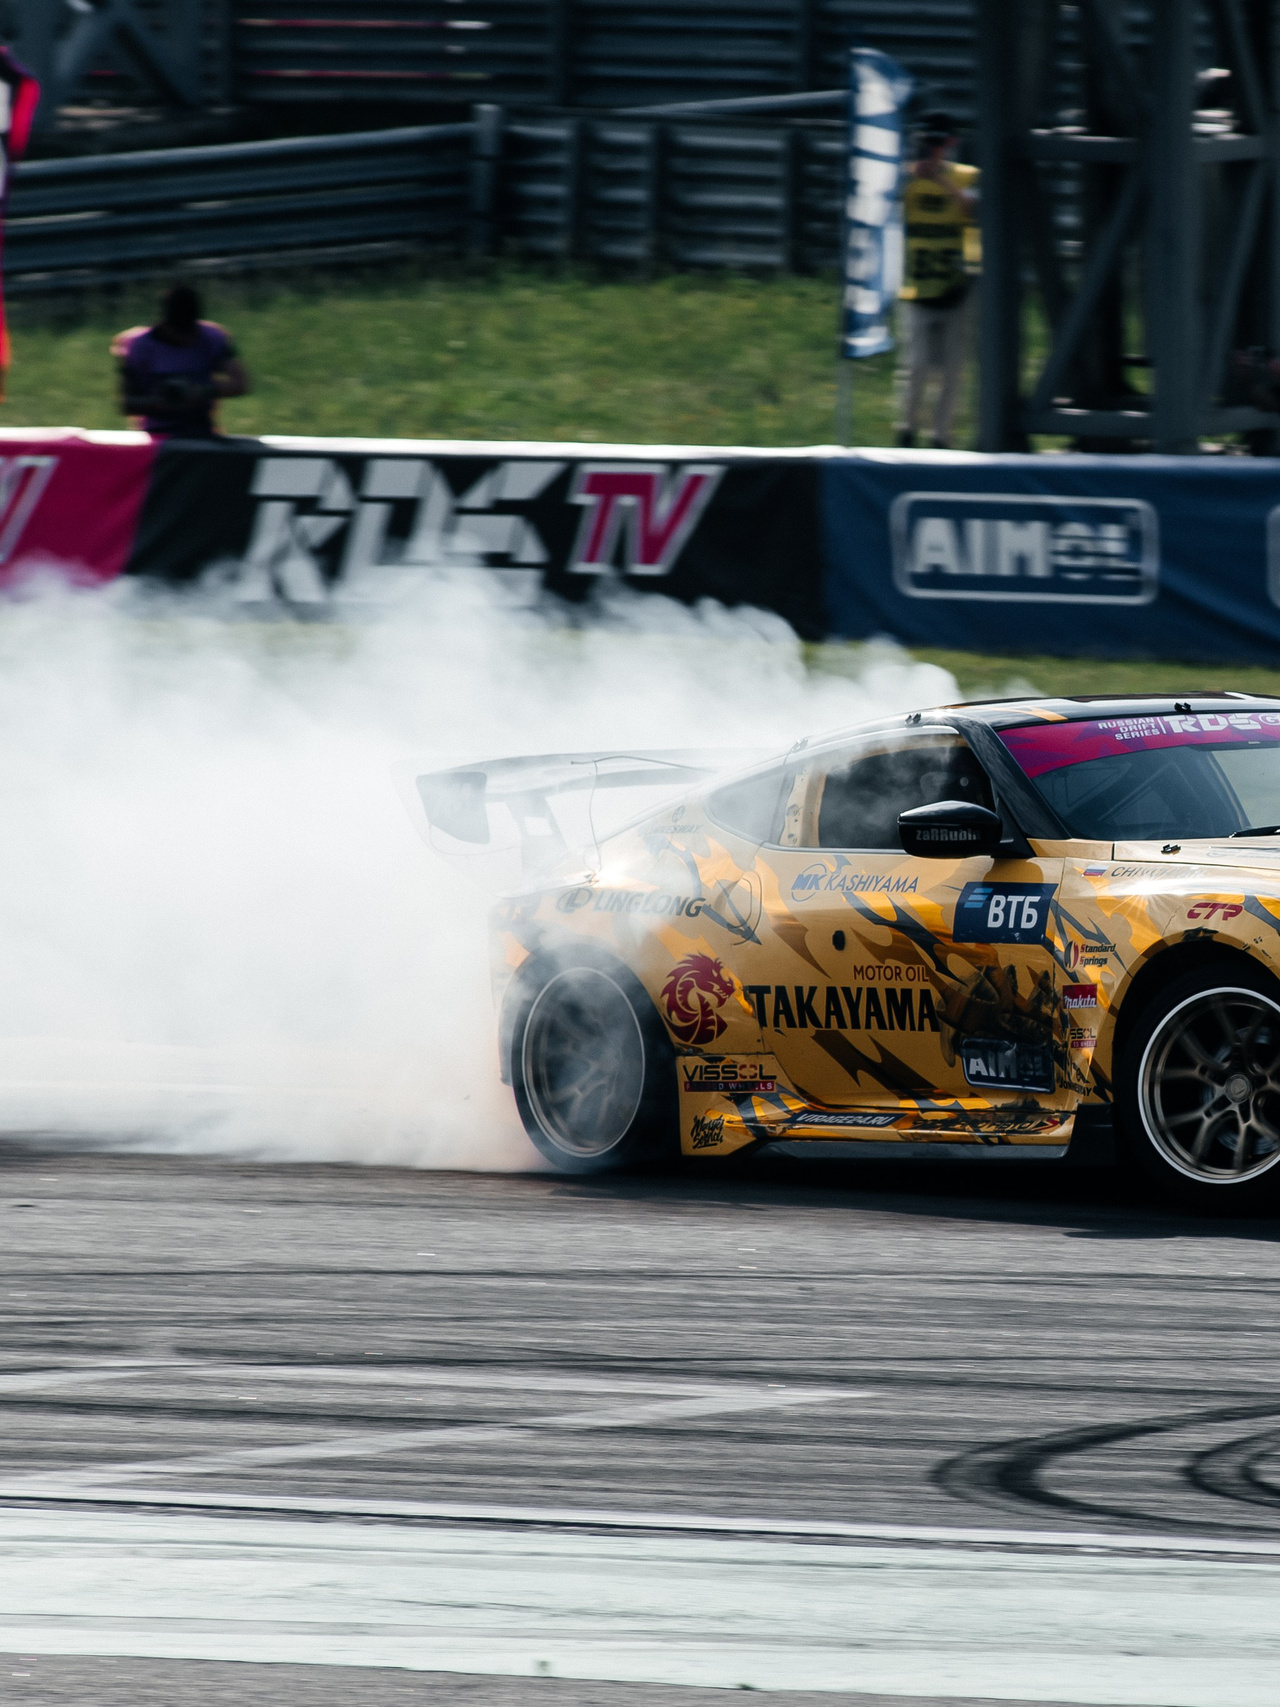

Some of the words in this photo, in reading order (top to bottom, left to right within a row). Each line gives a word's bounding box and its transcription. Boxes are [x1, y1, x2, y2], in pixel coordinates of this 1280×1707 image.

[570, 463, 727, 575] TV
[909, 516, 1140, 581] AIMOL
[1098, 717, 1155, 729] RUSSIAN
[1119, 723, 1157, 733] DRIFT
[1115, 728, 1160, 741] SERIES
[824, 874, 919, 893] KASHIYAMA
[592, 890, 707, 917] LINGLONG
[987, 895, 1042, 929] ВТБ
[1080, 943, 1117, 953] Standard
[1079, 956, 1108, 967] Springs
[854, 965, 903, 981] MOTOR
[905, 966, 929, 982] OIL
[748, 985, 941, 1032] TAKAYAMA
[683, 1064, 777, 1081] VISSOL
